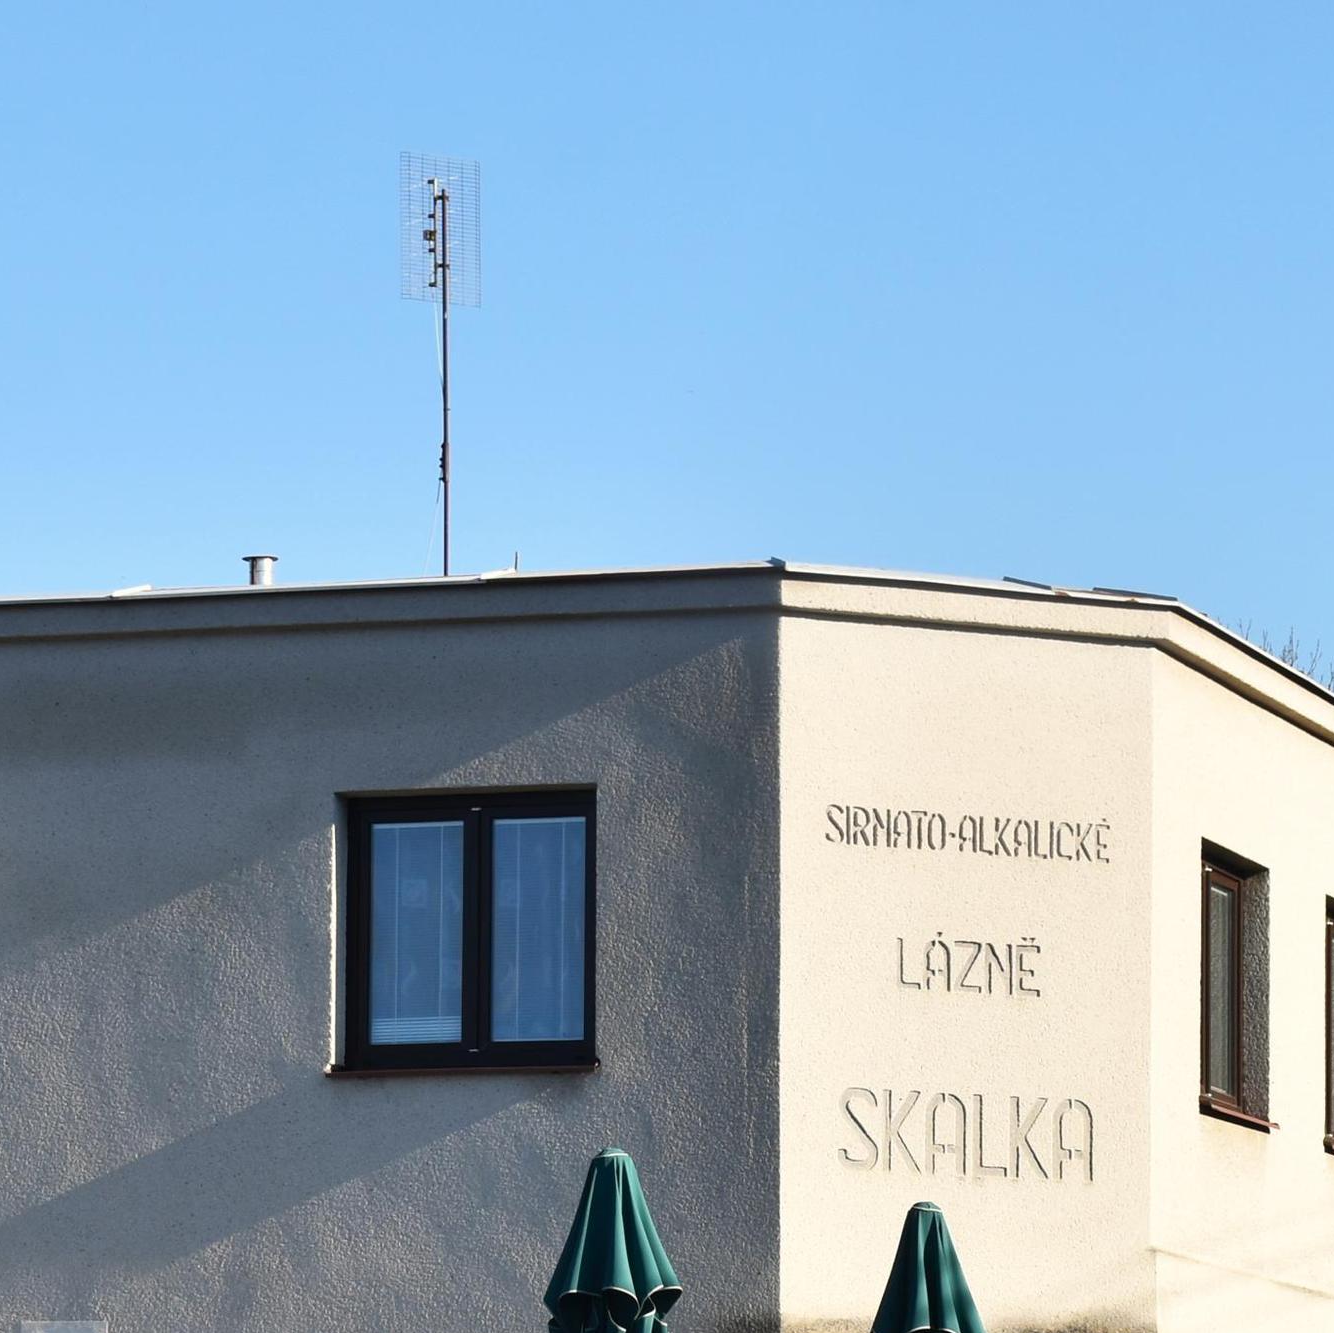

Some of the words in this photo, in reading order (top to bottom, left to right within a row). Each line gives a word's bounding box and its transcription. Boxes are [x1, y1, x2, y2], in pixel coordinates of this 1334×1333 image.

[824, 804, 1111, 864] SIRNATO-ALKALICKÉ
[896, 931, 1042, 998] LÁZNĚ
[837, 1086, 1095, 1183] SKALKA
